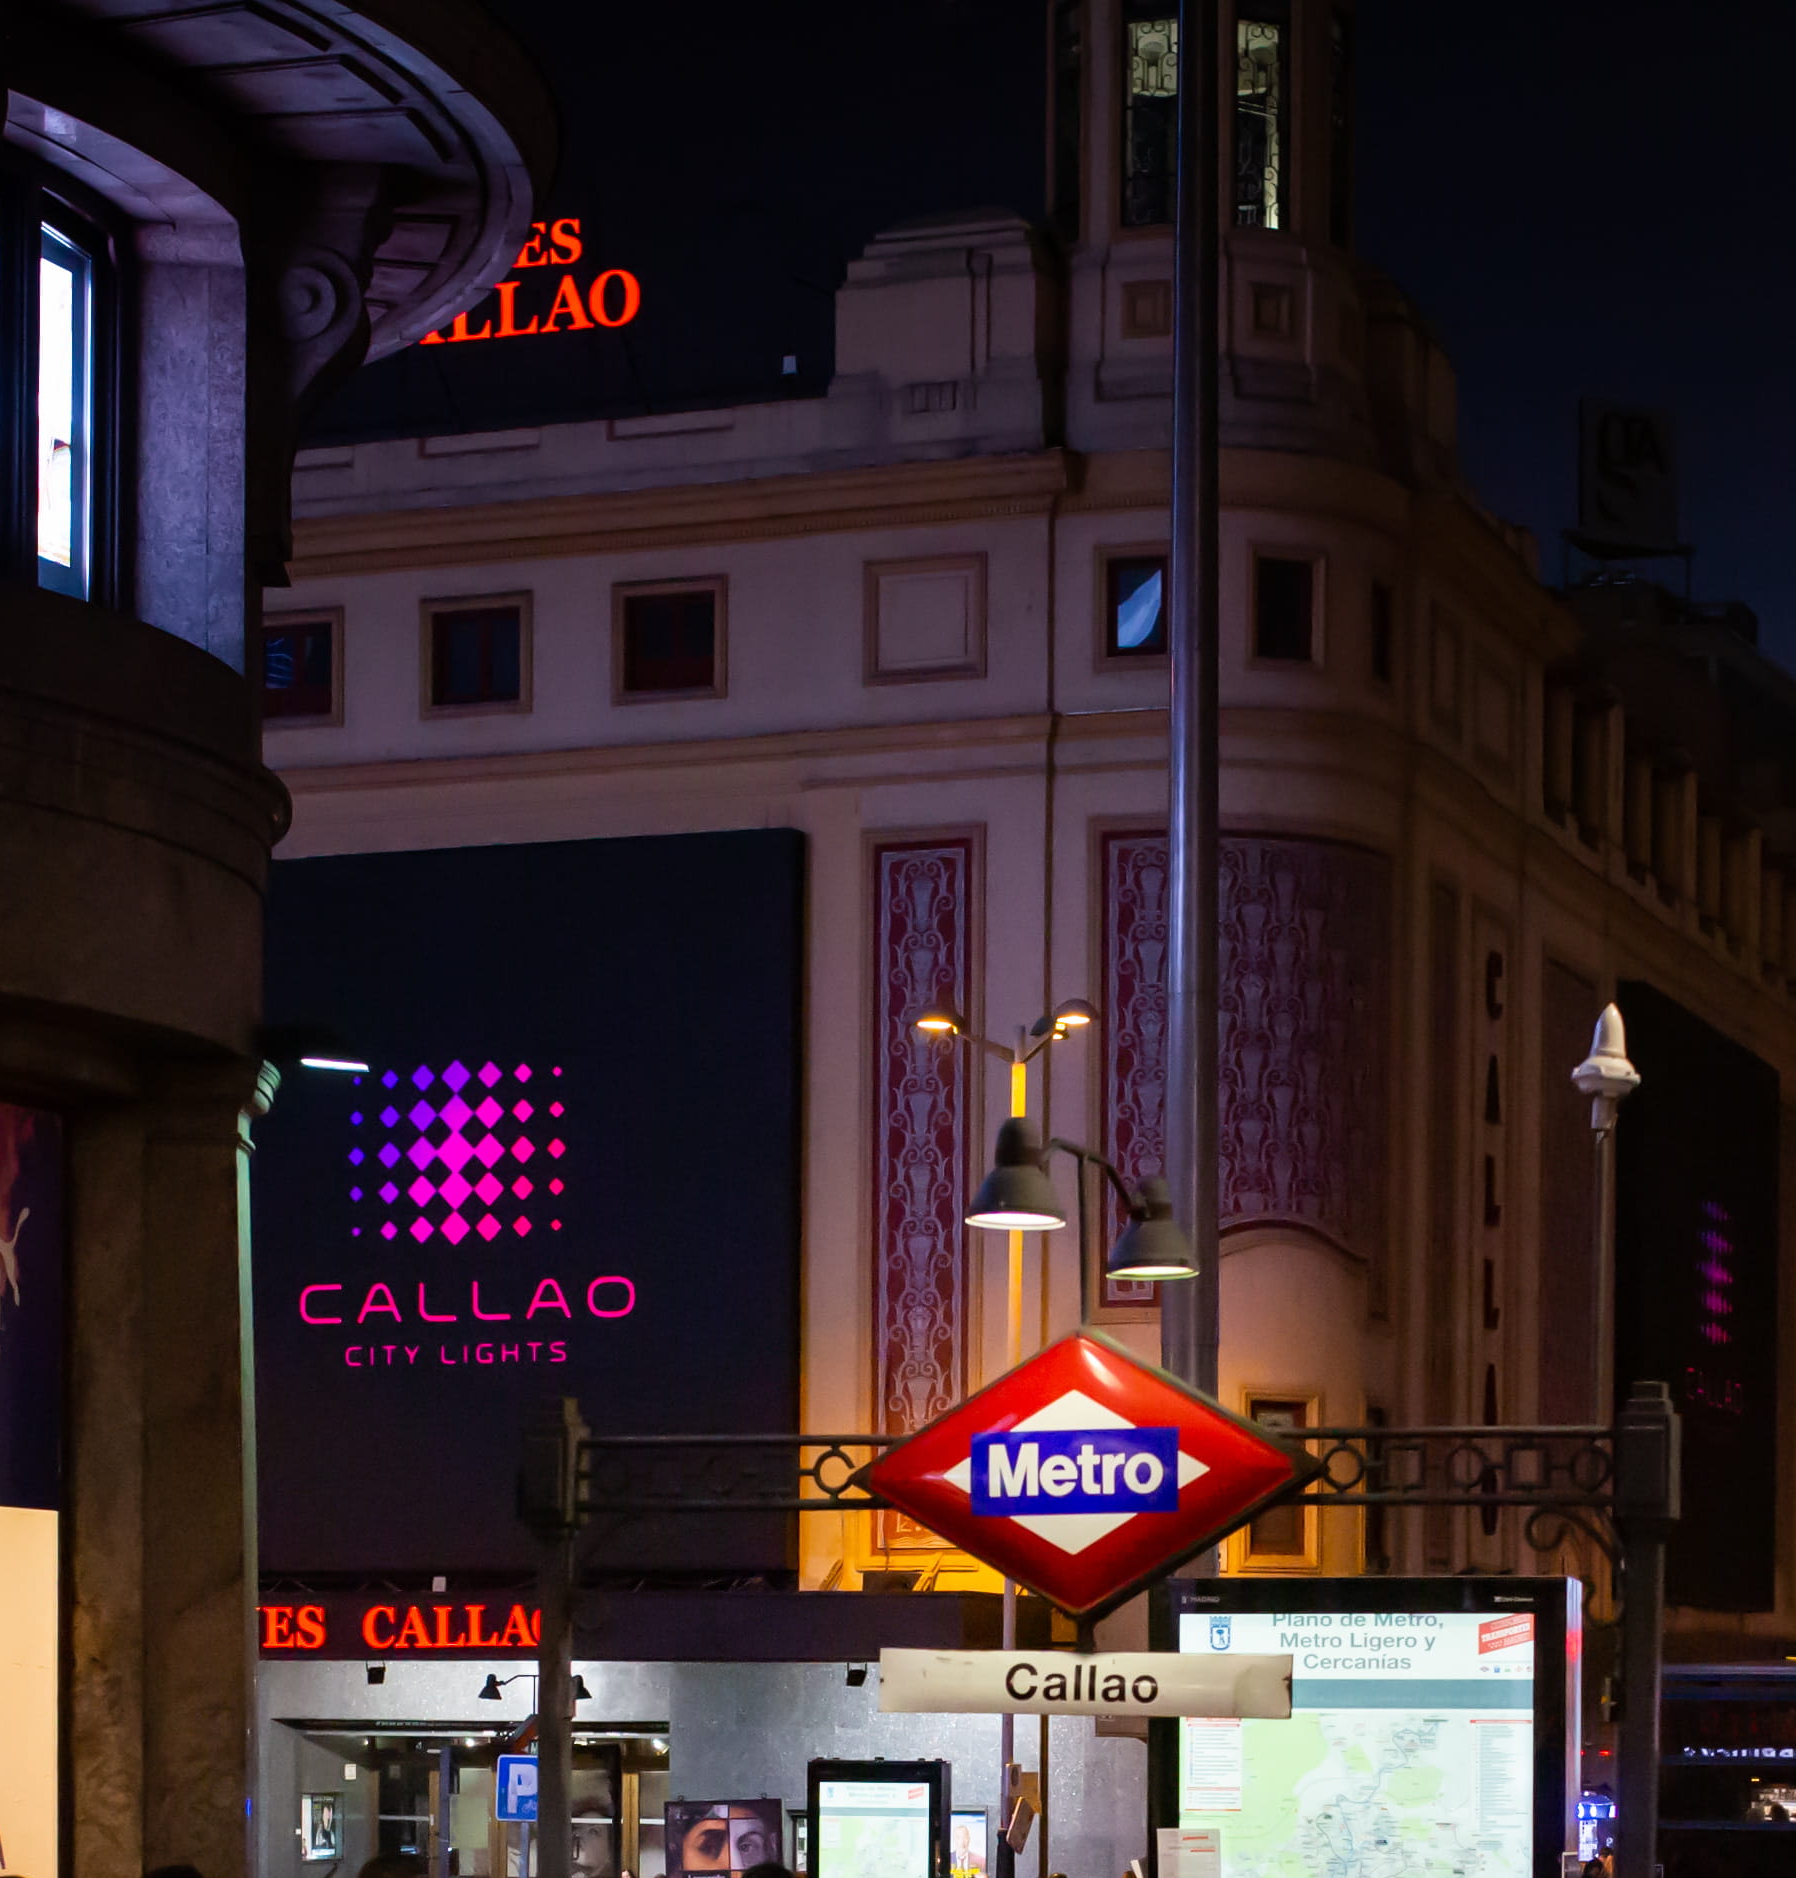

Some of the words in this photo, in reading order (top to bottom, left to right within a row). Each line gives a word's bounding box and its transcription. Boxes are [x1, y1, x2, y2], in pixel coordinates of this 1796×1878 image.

[300, 1276, 636, 1324] CALLAO
[345, 1346, 419, 1366] CITY
[441, 1341, 568, 1364] LIGHTS
[988, 1443, 1165, 1498] Metro
[255, 1604, 327, 1650] ES
[362, 1604, 542, 1650] CALLA
[1273, 1613, 1332, 1627] Plano
[1340, 1613, 1367, 1627] de
[1374, 1613, 1444, 1629] Metro,
[1280, 1632, 1342, 1648] Metro
[1350, 1632, 1417, 1652] Ligero
[1425, 1635, 1436, 1652] y
[1304, 1653, 1412, 1670] Cercanías
[1005, 1662, 1160, 1703] Callao
[507, 1763, 538, 1813] P
